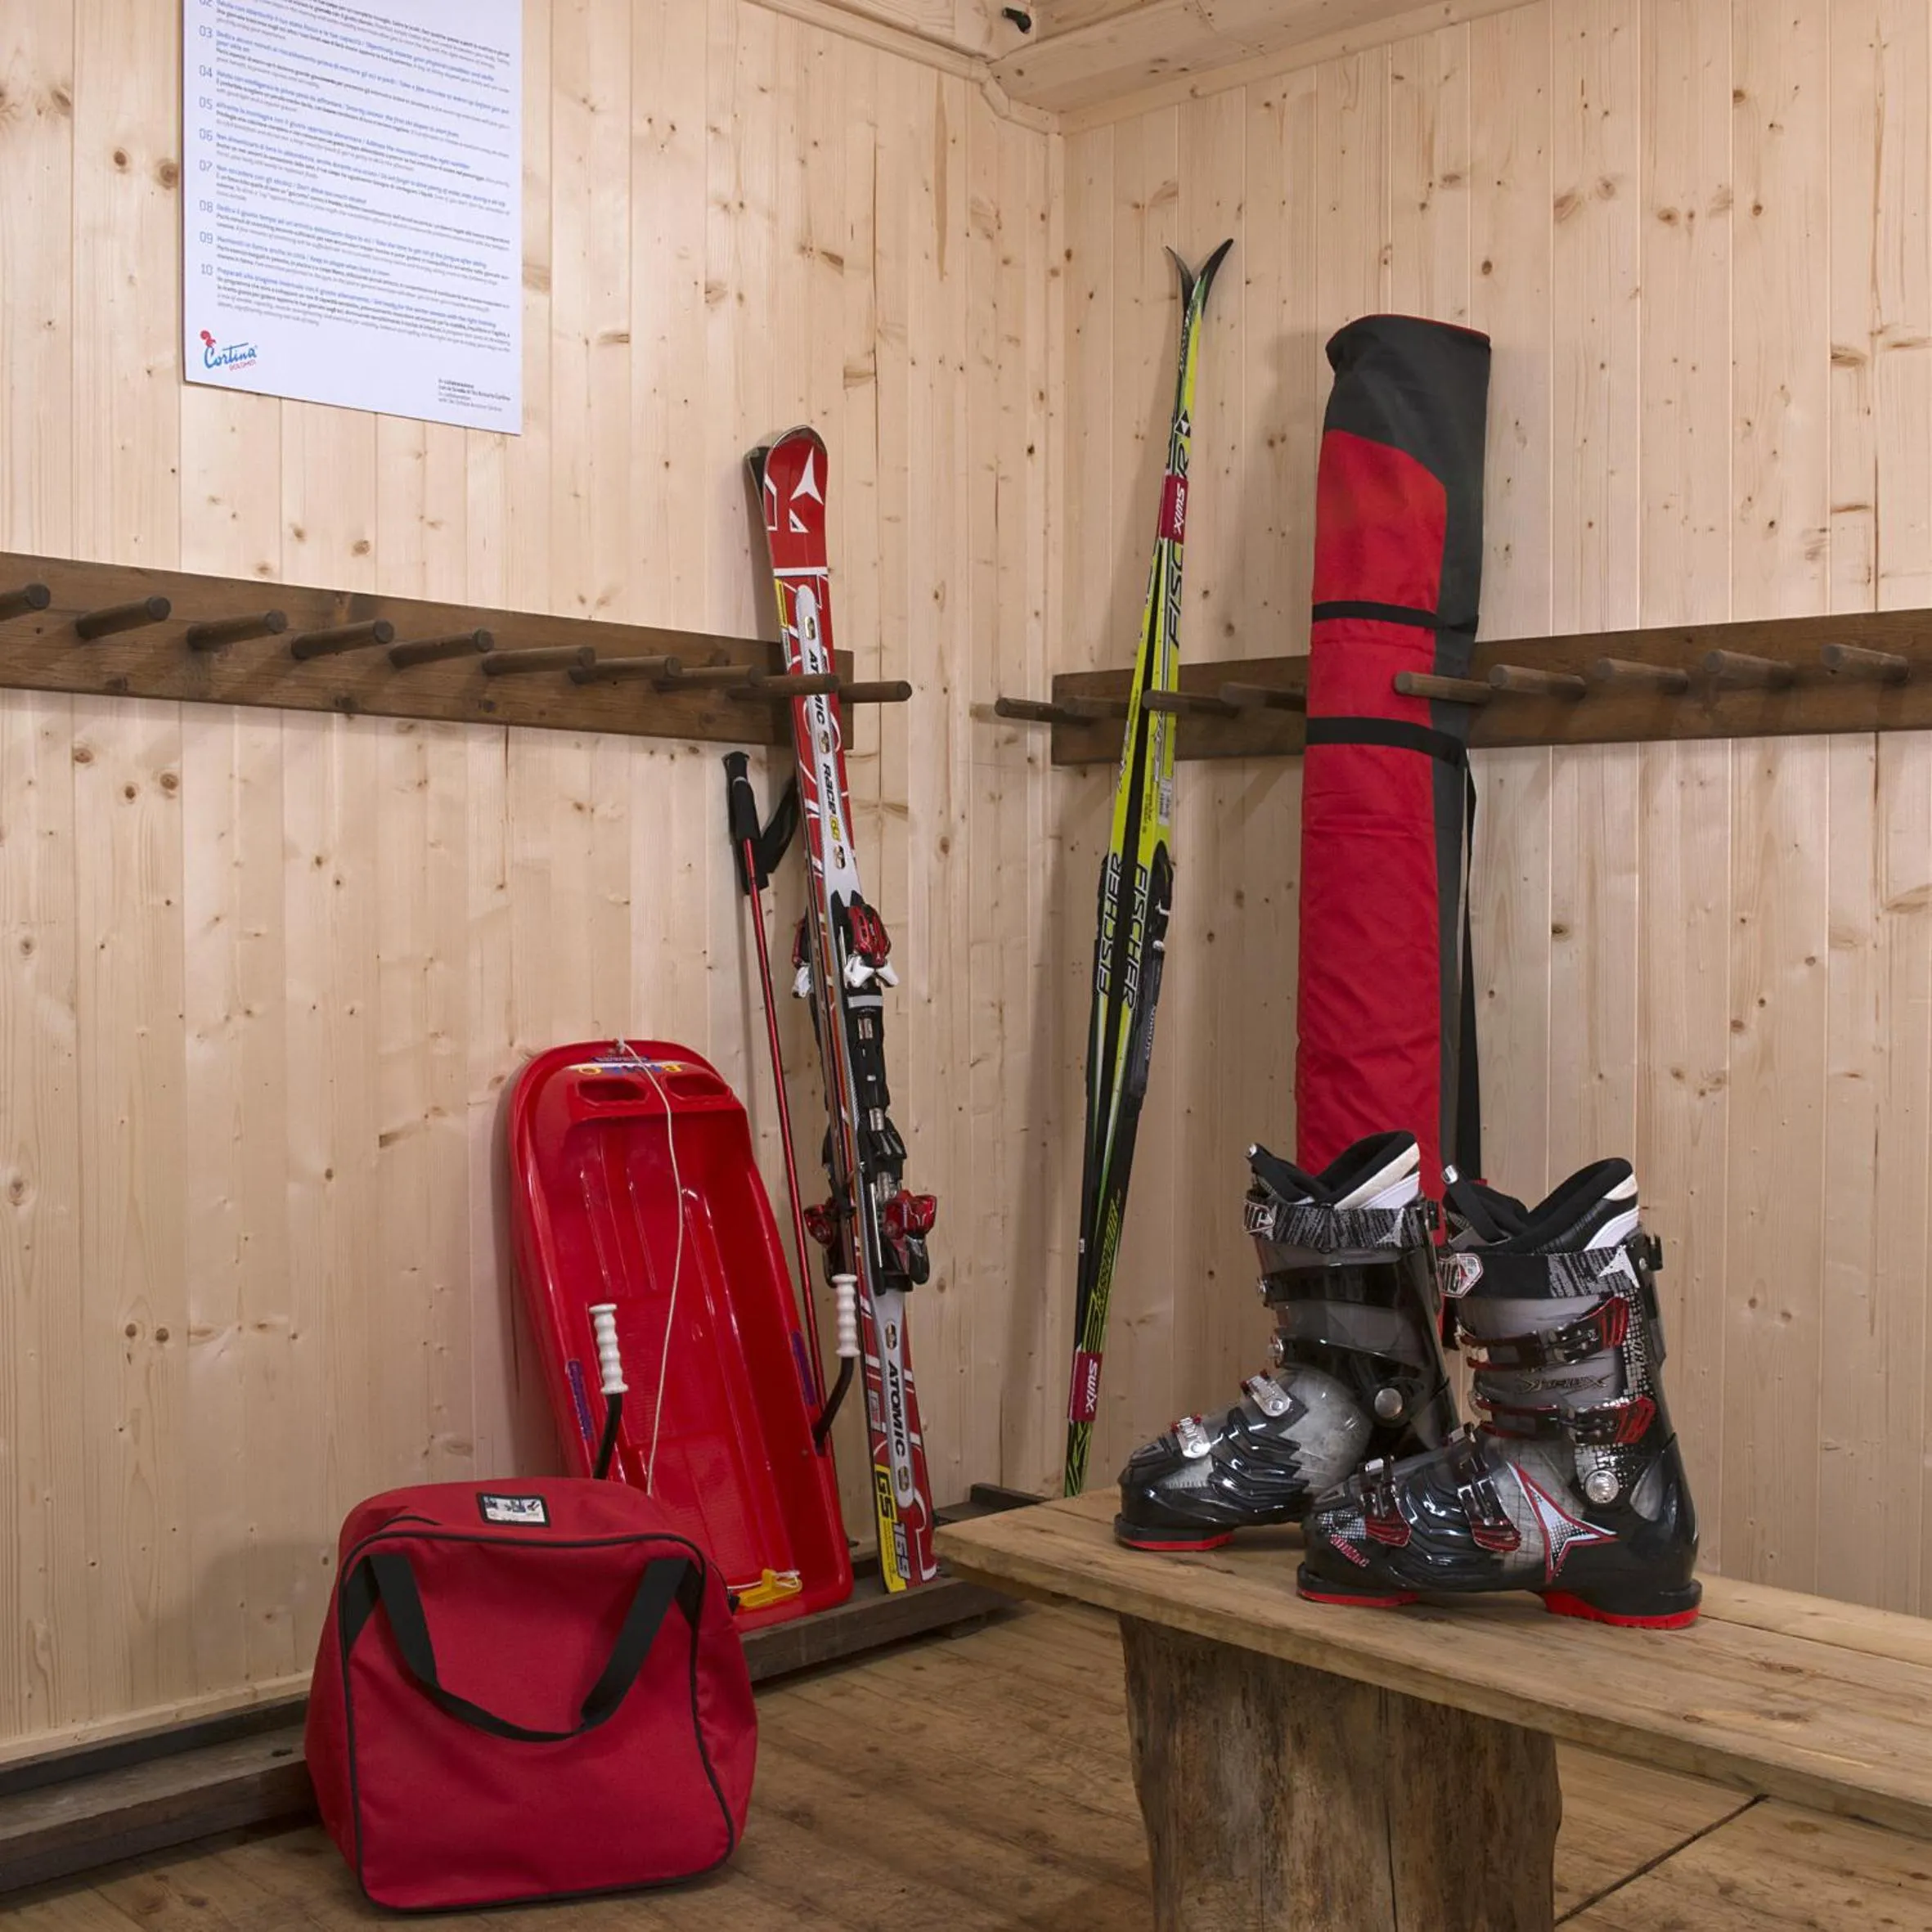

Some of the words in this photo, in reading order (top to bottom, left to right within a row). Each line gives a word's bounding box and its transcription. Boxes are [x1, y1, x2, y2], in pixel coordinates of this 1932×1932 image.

[199, 25, 213, 38] 03
[199, 65, 213, 78] 04
[199, 97, 213, 110] 05
[199, 128, 213, 142] 06
[199, 160, 213, 172] 07
[200, 200, 213, 213] 08
[200, 231, 213, 244] 09
[201, 263, 213, 276] 10
[204, 342, 258, 369] Cortina
[1098, 852, 1123, 995] FISCHER
[1123, 863, 1148, 1009] FISCHER
[888, 1359, 905, 1457] ATOMIC
[876, 1470, 894, 1521] GS
